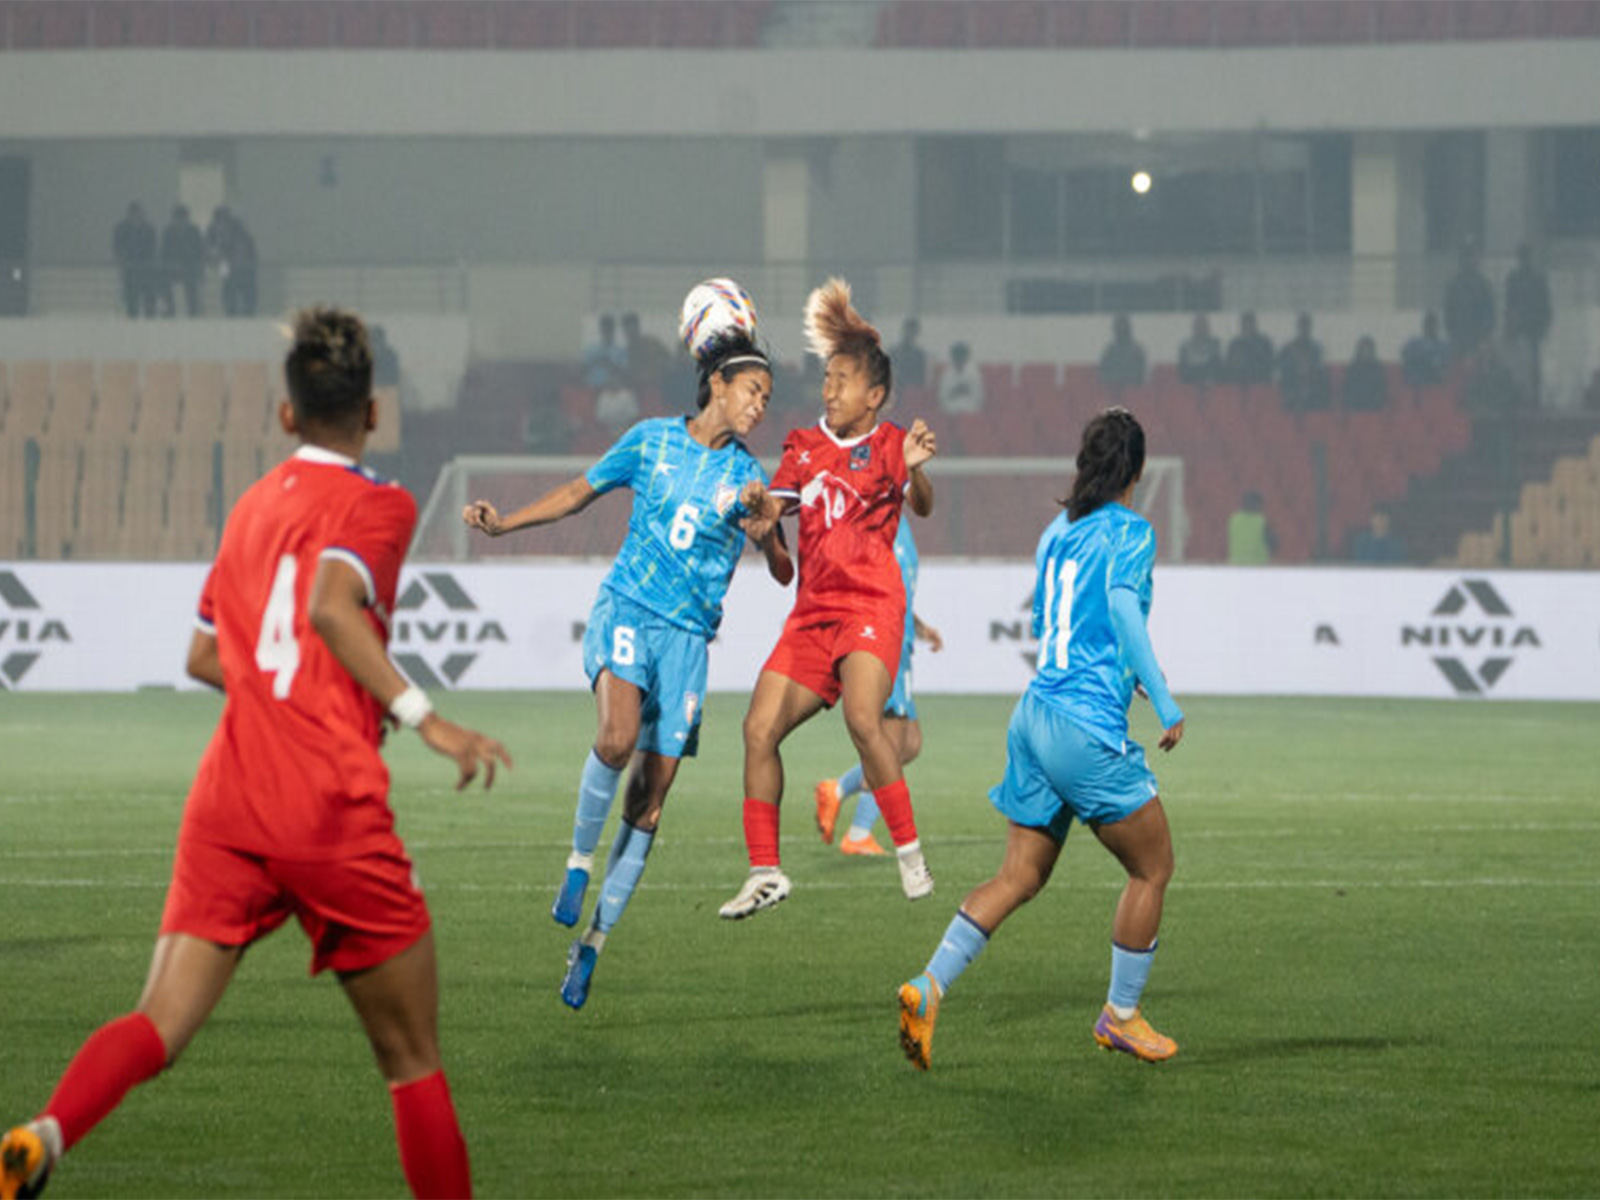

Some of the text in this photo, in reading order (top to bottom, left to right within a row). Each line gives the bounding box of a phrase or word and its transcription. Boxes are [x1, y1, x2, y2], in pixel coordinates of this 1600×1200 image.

[669, 503, 699, 550] 6
[255, 553, 300, 699] 4
[398, 620, 508, 642] IVIA
[1038, 557, 1077, 670] 11
[612, 625, 636, 666] 6
[1401, 625, 1542, 648] NIVIA
